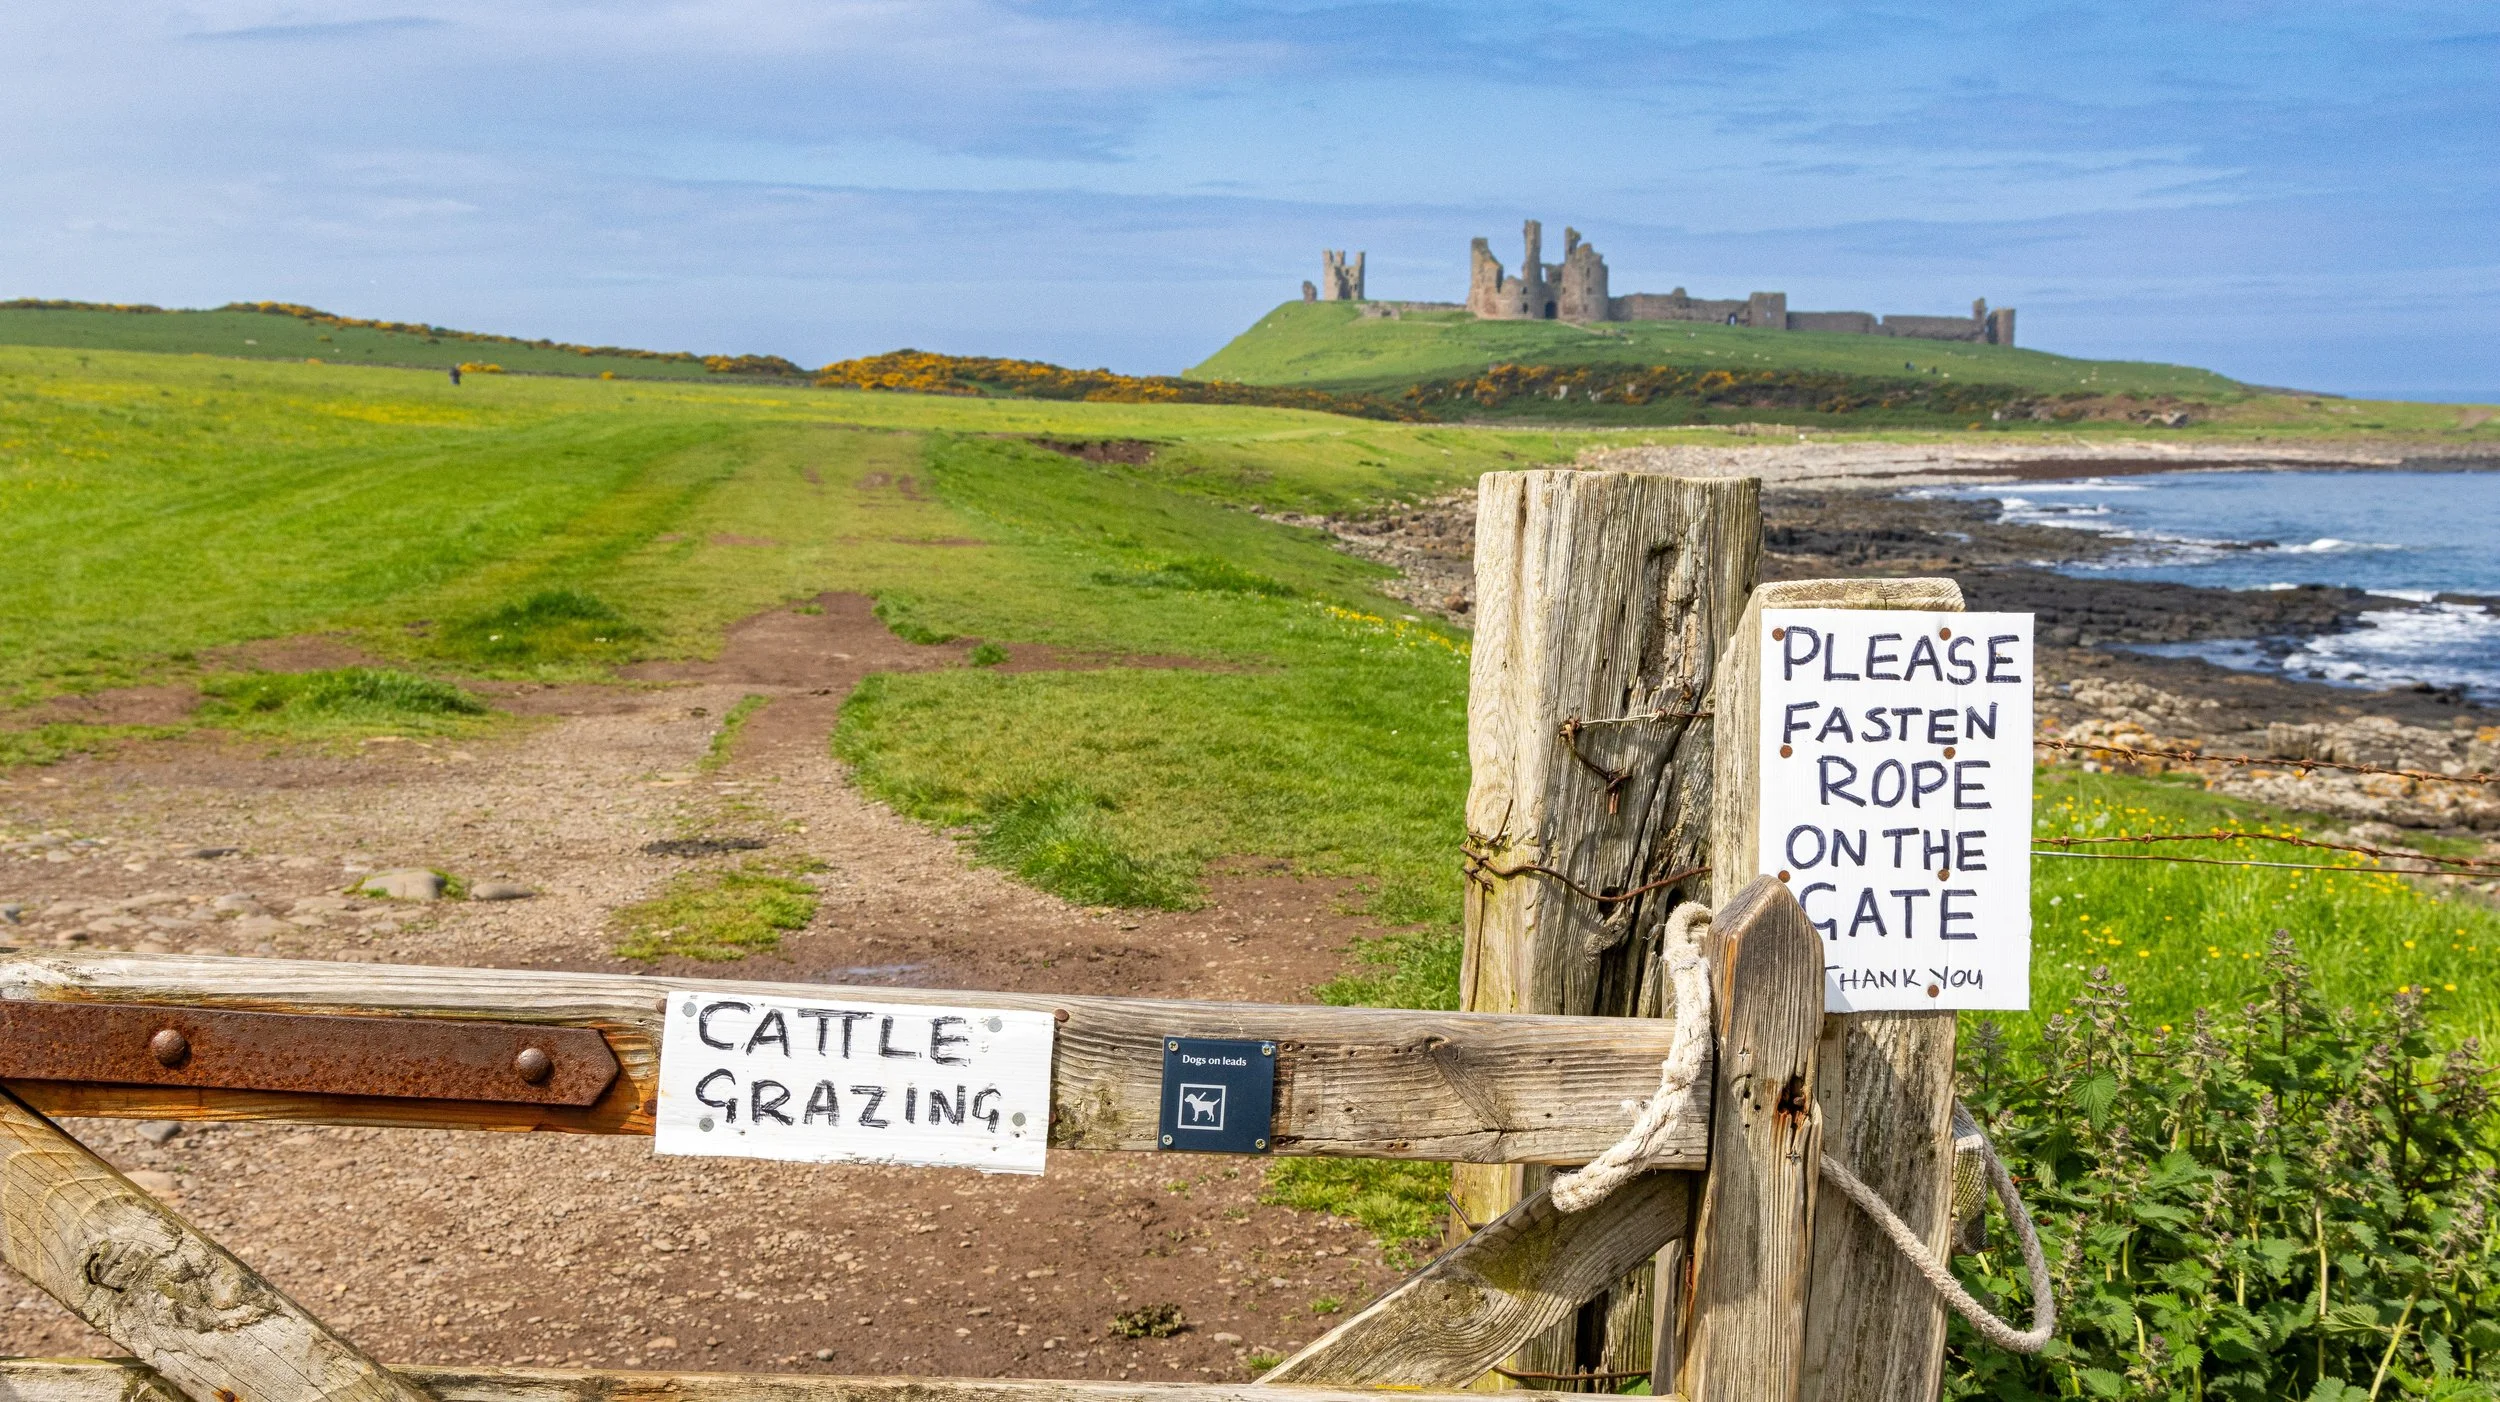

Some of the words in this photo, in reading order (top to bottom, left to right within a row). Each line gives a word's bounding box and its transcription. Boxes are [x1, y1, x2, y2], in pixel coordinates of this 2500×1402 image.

[1784, 626, 2021, 685] PLEASE
[1783, 701, 1998, 744] FASTEN
[1817, 755, 1992, 809] ROPE
[1786, 825, 1867, 870] ON
[1882, 827, 1987, 871] THE
[1799, 882, 1978, 941] GATE
[1929, 966, 1983, 990] YOU
[699, 1001, 971, 1066] CATTLE
[1182, 1054, 1206, 1066] Dogs
[1208, 1057, 1220, 1065] on
[1222, 1056, 1247, 1066] leads
[695, 1068, 1001, 1133] GRAZING
